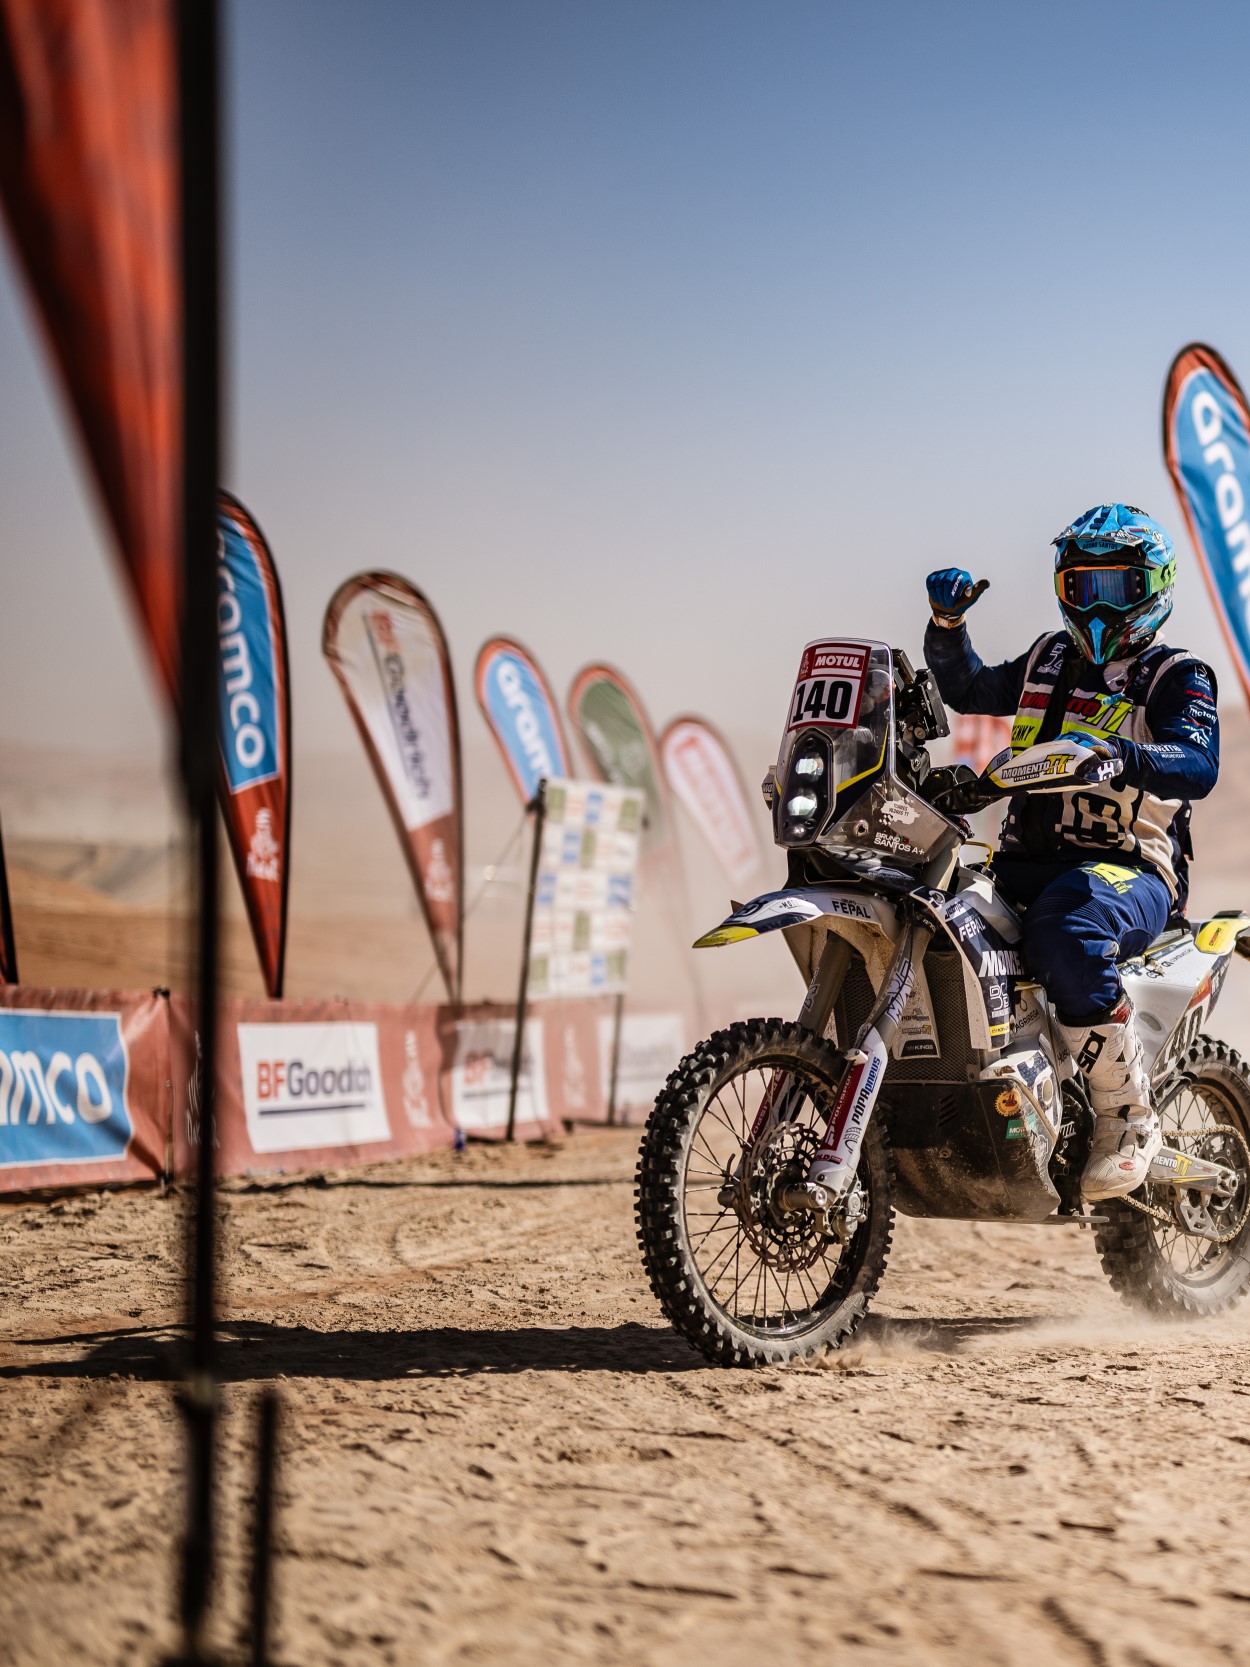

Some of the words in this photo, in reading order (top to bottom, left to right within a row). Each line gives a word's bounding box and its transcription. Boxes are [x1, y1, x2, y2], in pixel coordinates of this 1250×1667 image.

[815, 655, 860, 668] MOTUL
[792, 680, 853, 724] 140
[1002, 761, 1050, 779] MOMENTO
[875, 832, 900, 843] BRUNO
[874, 838, 911, 852] SANTOS
[911, 847, 925, 856] A+
[831, 900, 871, 919] FEPAL
[959, 916, 986, 942] FEPAL
[1077, 1029, 1107, 1074] SIDI
